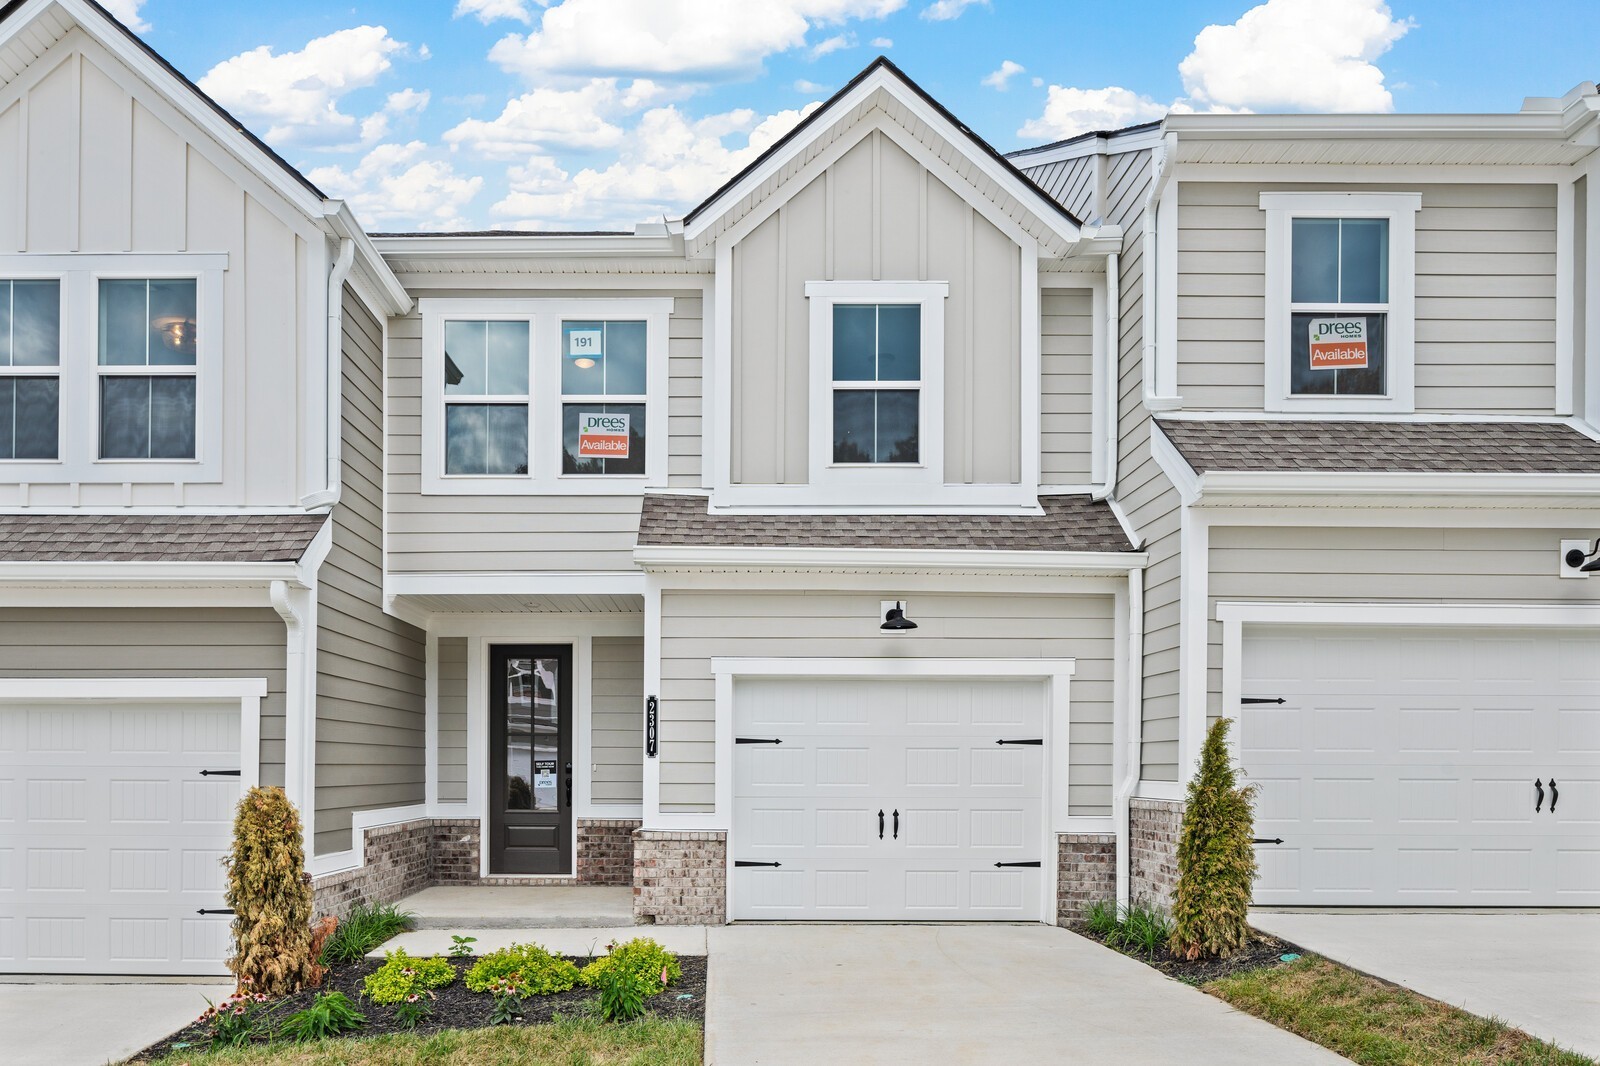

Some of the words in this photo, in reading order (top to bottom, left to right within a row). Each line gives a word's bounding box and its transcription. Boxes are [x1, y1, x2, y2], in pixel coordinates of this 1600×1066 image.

[574, 337, 592, 347] 191
[1312, 348, 1365, 360] Available
[581, 439, 627, 451] Available
